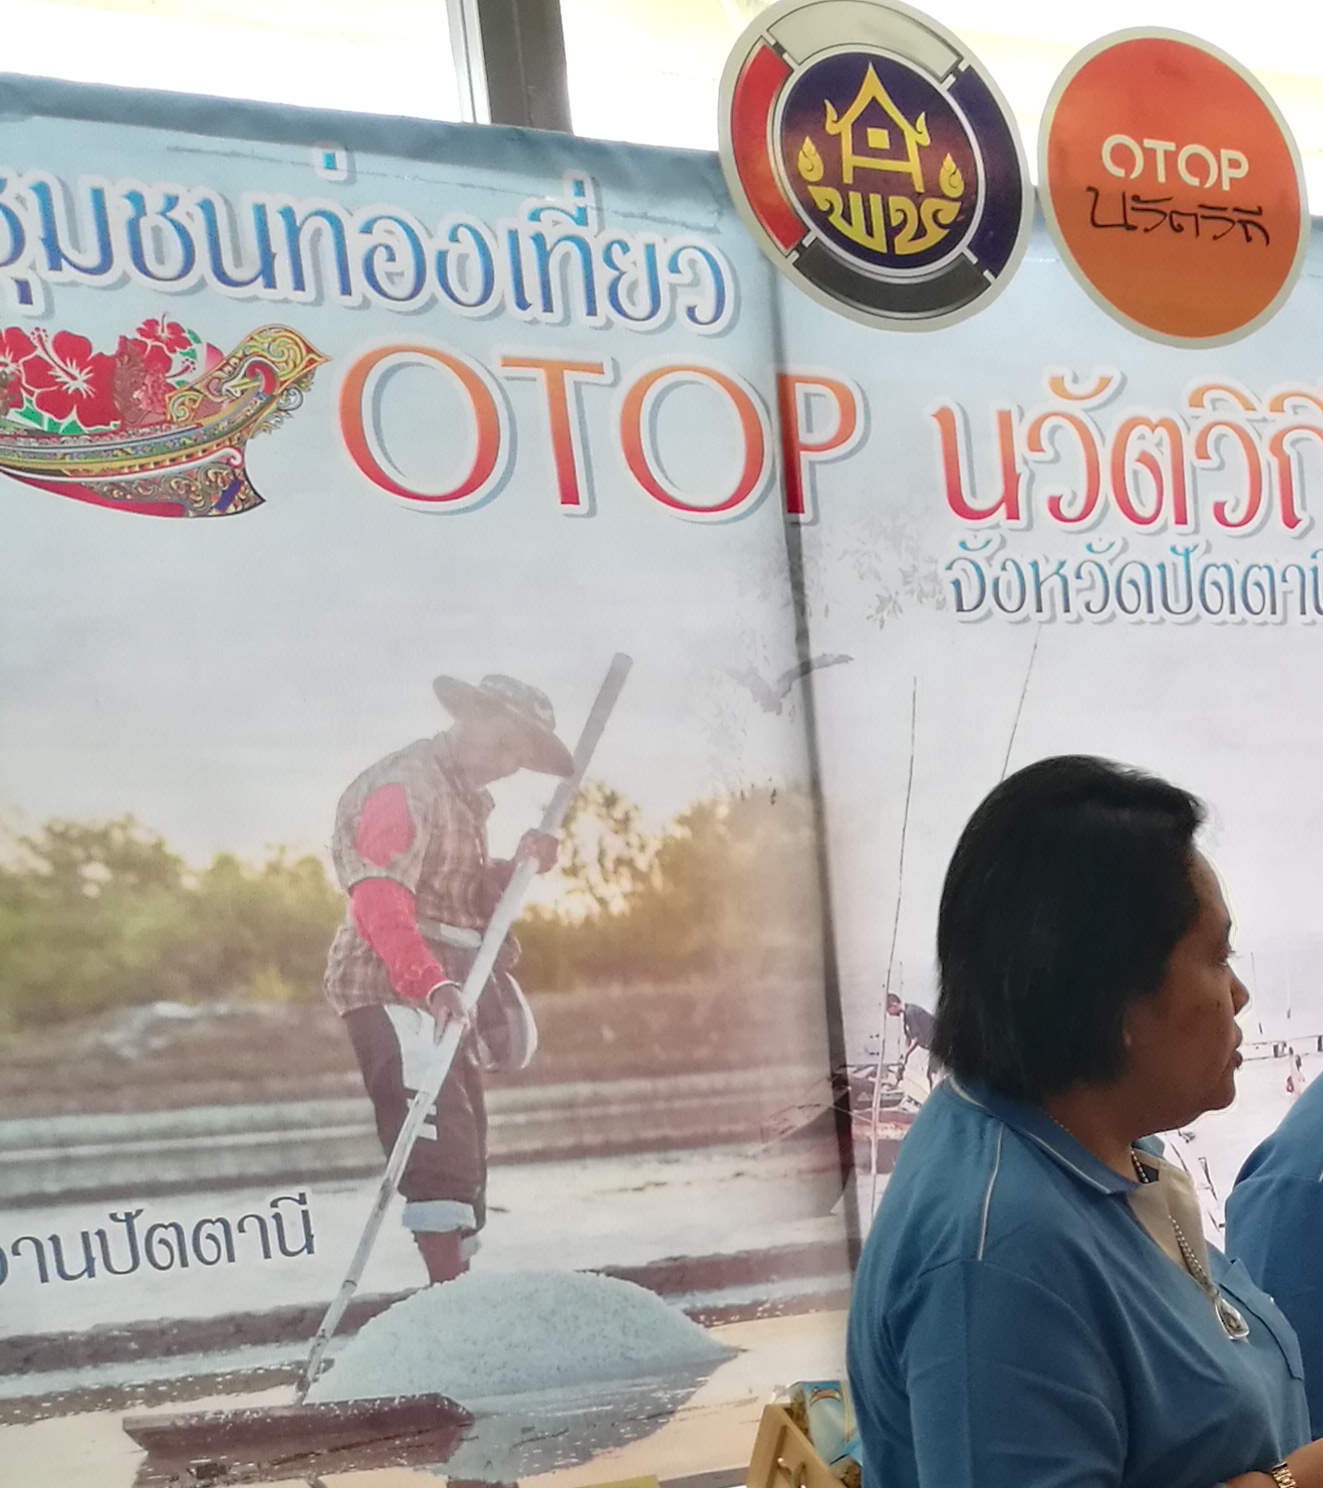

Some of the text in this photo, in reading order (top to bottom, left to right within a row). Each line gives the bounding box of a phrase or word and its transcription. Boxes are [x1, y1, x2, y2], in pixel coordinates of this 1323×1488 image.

[1101, 133, 1249, 191] OTOP
[337, 343, 860, 516] OTOP
[0, 1191, 316, 1286] านปัตตานี
